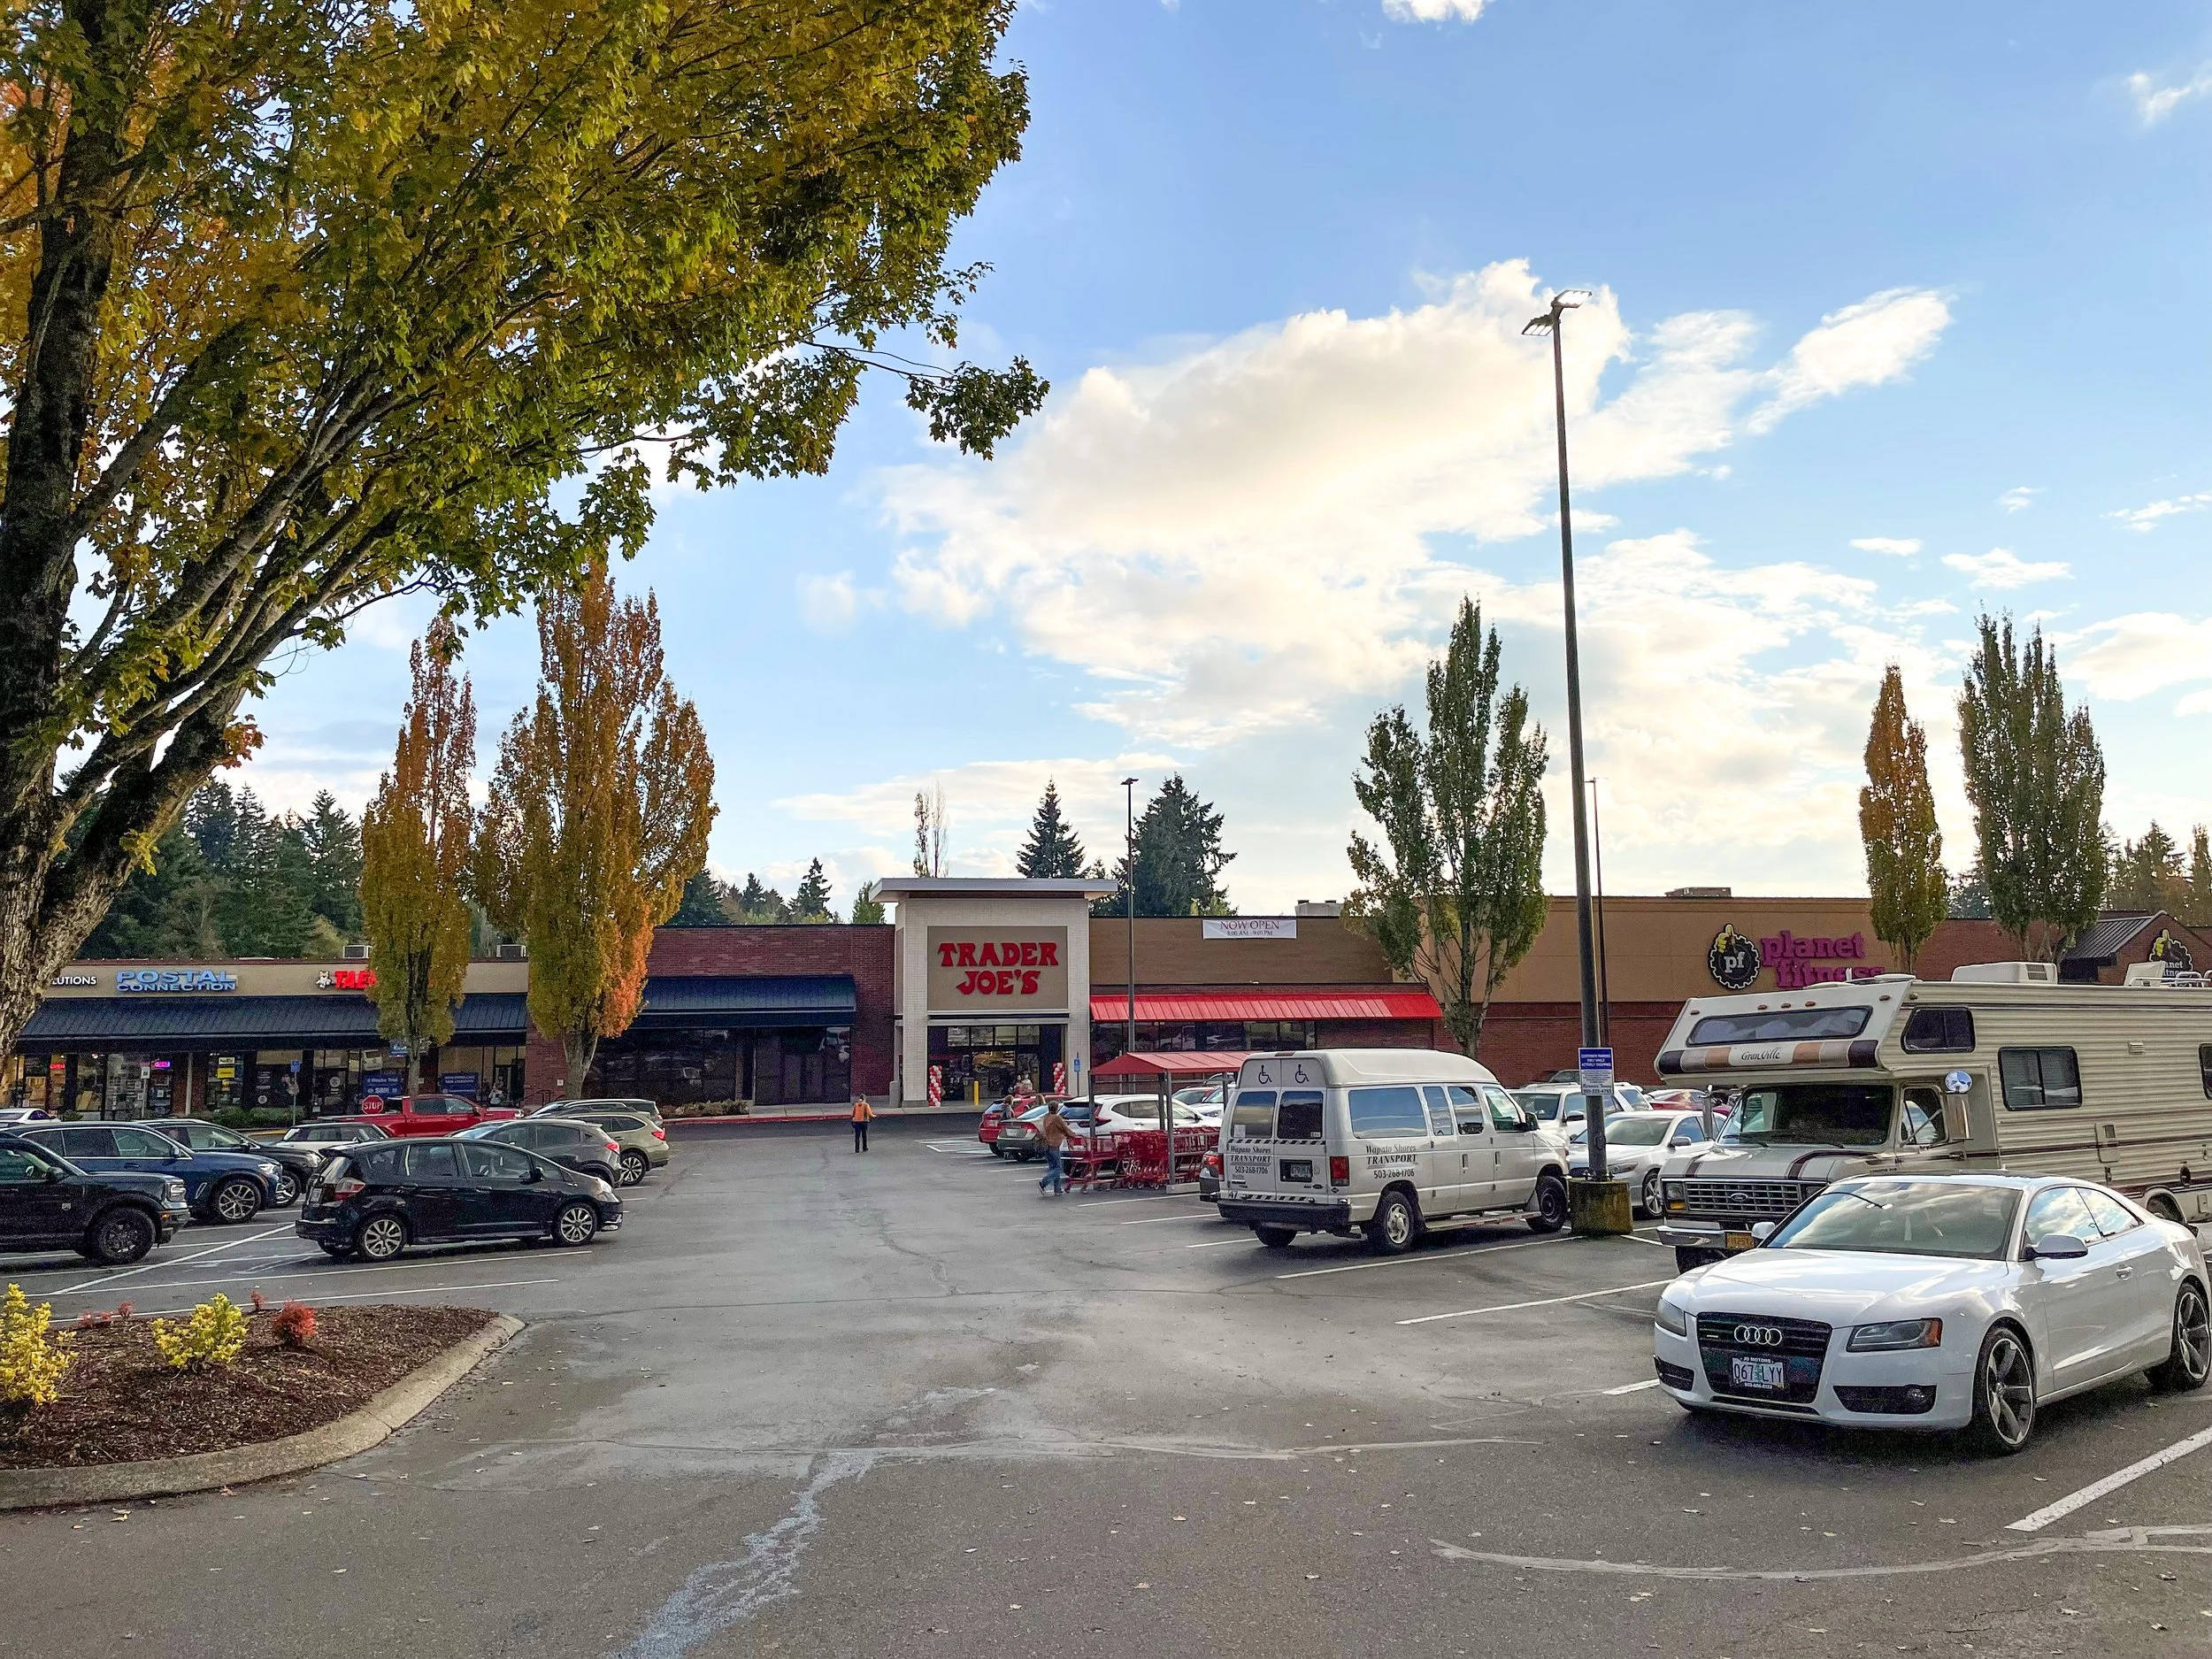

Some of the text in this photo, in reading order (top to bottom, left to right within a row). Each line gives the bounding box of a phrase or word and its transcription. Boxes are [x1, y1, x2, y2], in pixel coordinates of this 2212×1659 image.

[1220, 921, 1279, 930] NOW OPEN
[937, 942, 1059, 967] TRADER
[1760, 930, 1865, 967] planet
[1724, 951, 1746, 973] pf
[52, 976, 97, 986] LUTIONS
[116, 970, 236, 983] POSTAL
[956, 969, 1041, 995] JOE'S
[116, 982, 236, 992] CONNECTION
[364, 1102, 382, 1110] STOP
[1394, 1144, 1417, 1153] Shores
[1366, 1154, 1417, 1165] TRANSPORT
[1734, 1363, 1782, 1383] 067 LYY
